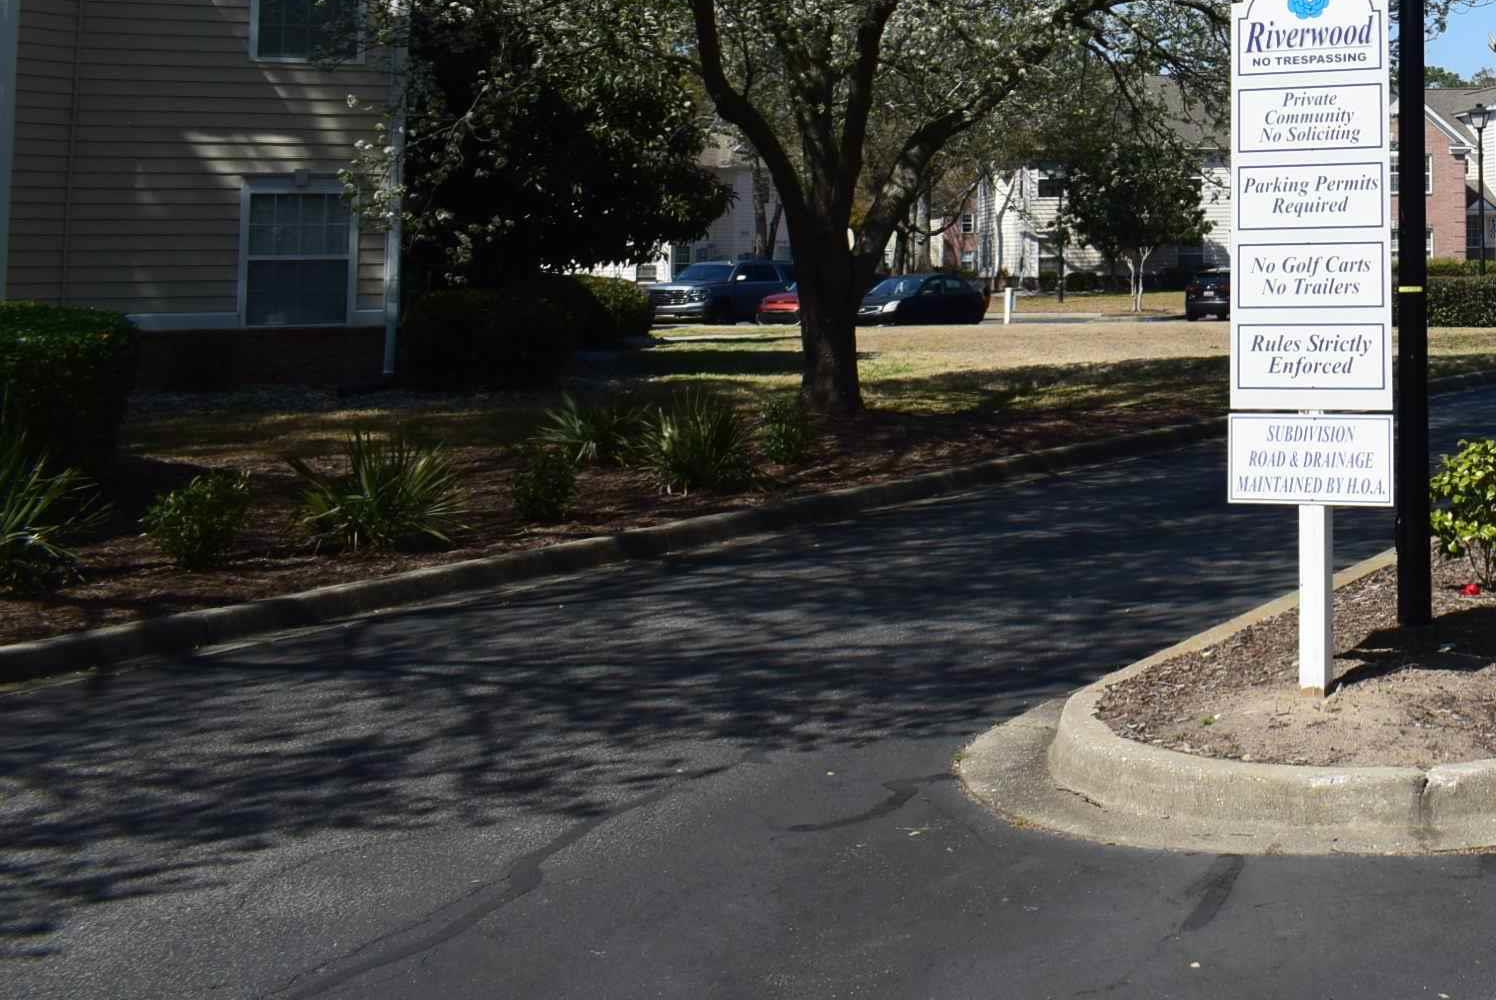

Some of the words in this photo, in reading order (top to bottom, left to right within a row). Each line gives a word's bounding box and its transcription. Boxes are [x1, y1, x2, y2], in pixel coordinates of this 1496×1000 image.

[1245, 15, 1373, 53] Riverwood
[1252, 56, 1271, 66] NO
[1275, 53, 1367, 66] TRESPASSING
[1283, 92, 1337, 107] Private
[1264, 107, 1355, 126] Community
[1259, 128, 1282, 143] No
[1286, 125, 1360, 143] Soliciting
[1244, 177, 1310, 196] Parking
[1315, 174, 1378, 192] Permits
[1272, 197, 1349, 218] Required
[1250, 257, 1275, 273] No
[1282, 256, 1322, 277] Golf
[1325, 256, 1371, 273] Carts
[1262, 279, 1286, 295] No
[1294, 278, 1360, 295] Trailers
[1251, 334, 1301, 352] Rules
[1307, 334, 1372, 356] Strictly
[1267, 356, 1354, 379] Enforced
[1267, 425, 1356, 443] SUBDIVISION
[1249, 450, 1286, 467] ROAD
[1290, 451, 1299, 467] &
[1303, 451, 1374, 469] DRAINAGE
[1237, 476, 1323, 493] MAINTAINED
[1326, 477, 1344, 493] BY
[1347, 477, 1386, 495] H.O.A.
